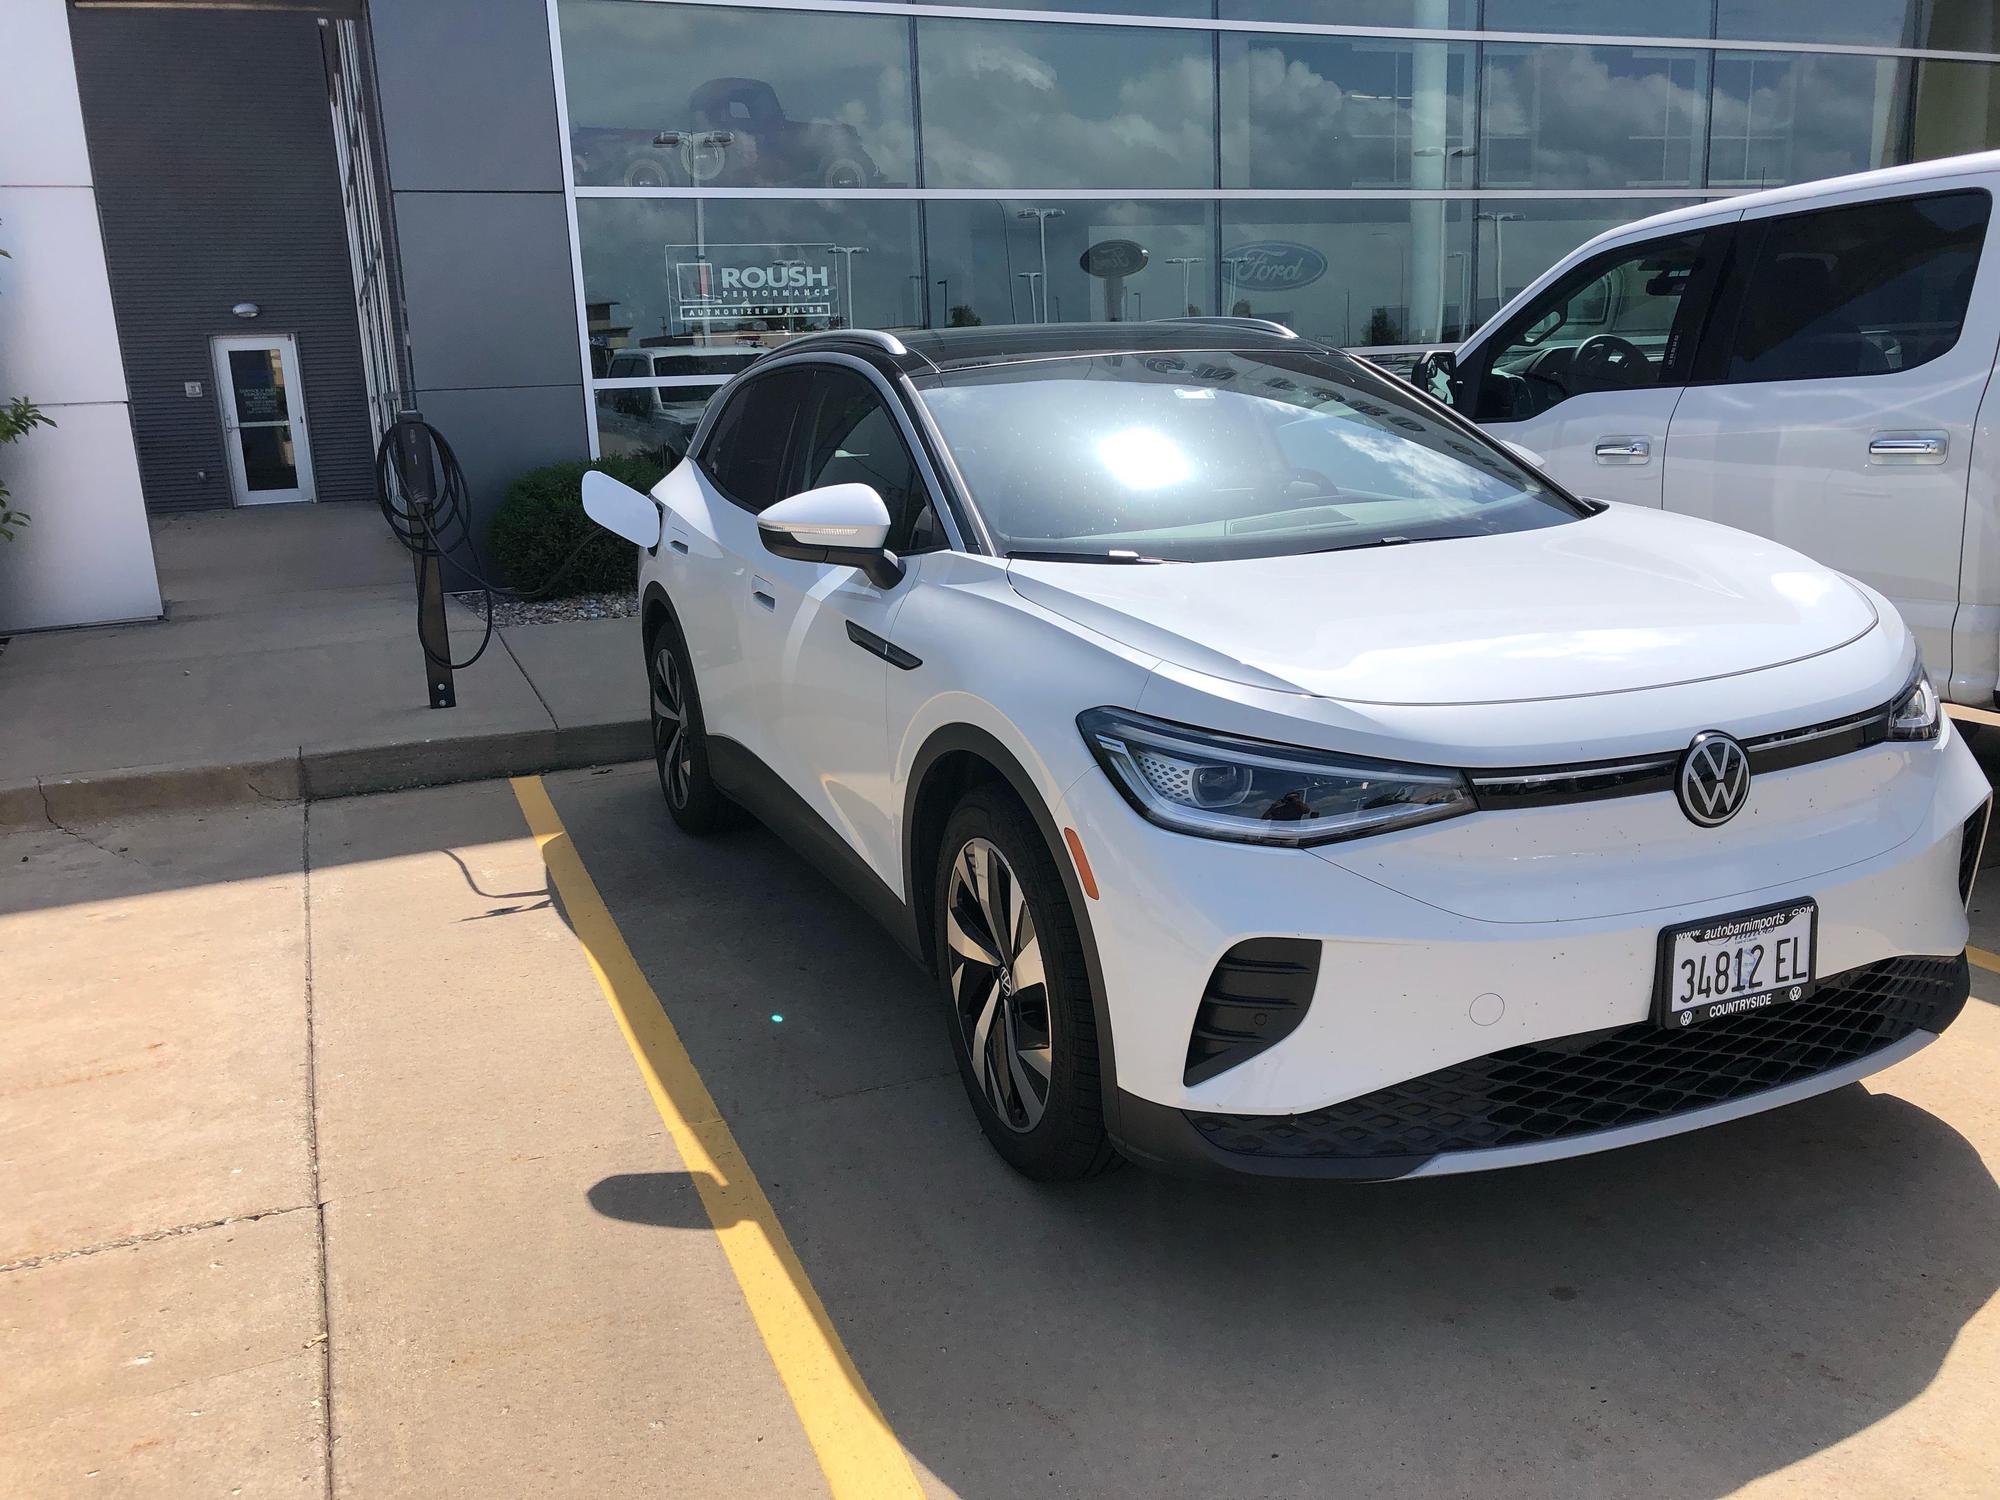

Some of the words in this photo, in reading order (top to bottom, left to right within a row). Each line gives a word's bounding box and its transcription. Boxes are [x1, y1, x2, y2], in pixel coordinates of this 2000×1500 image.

[1237, 248, 1304, 281] Ford
[722, 266, 828, 289] ROUSH
[722, 289, 829, 298] PERFORMANCE
[689, 307, 769, 316] AUTHORIZED
[777, 306, 822, 315] DEALER
[1704, 912, 1785, 940] autobarnimports
[1680, 944, 1765, 1003] 34812
[1775, 937, 1807, 983] EL
[1709, 993, 1772, 1018] COUNTRYSIDE
